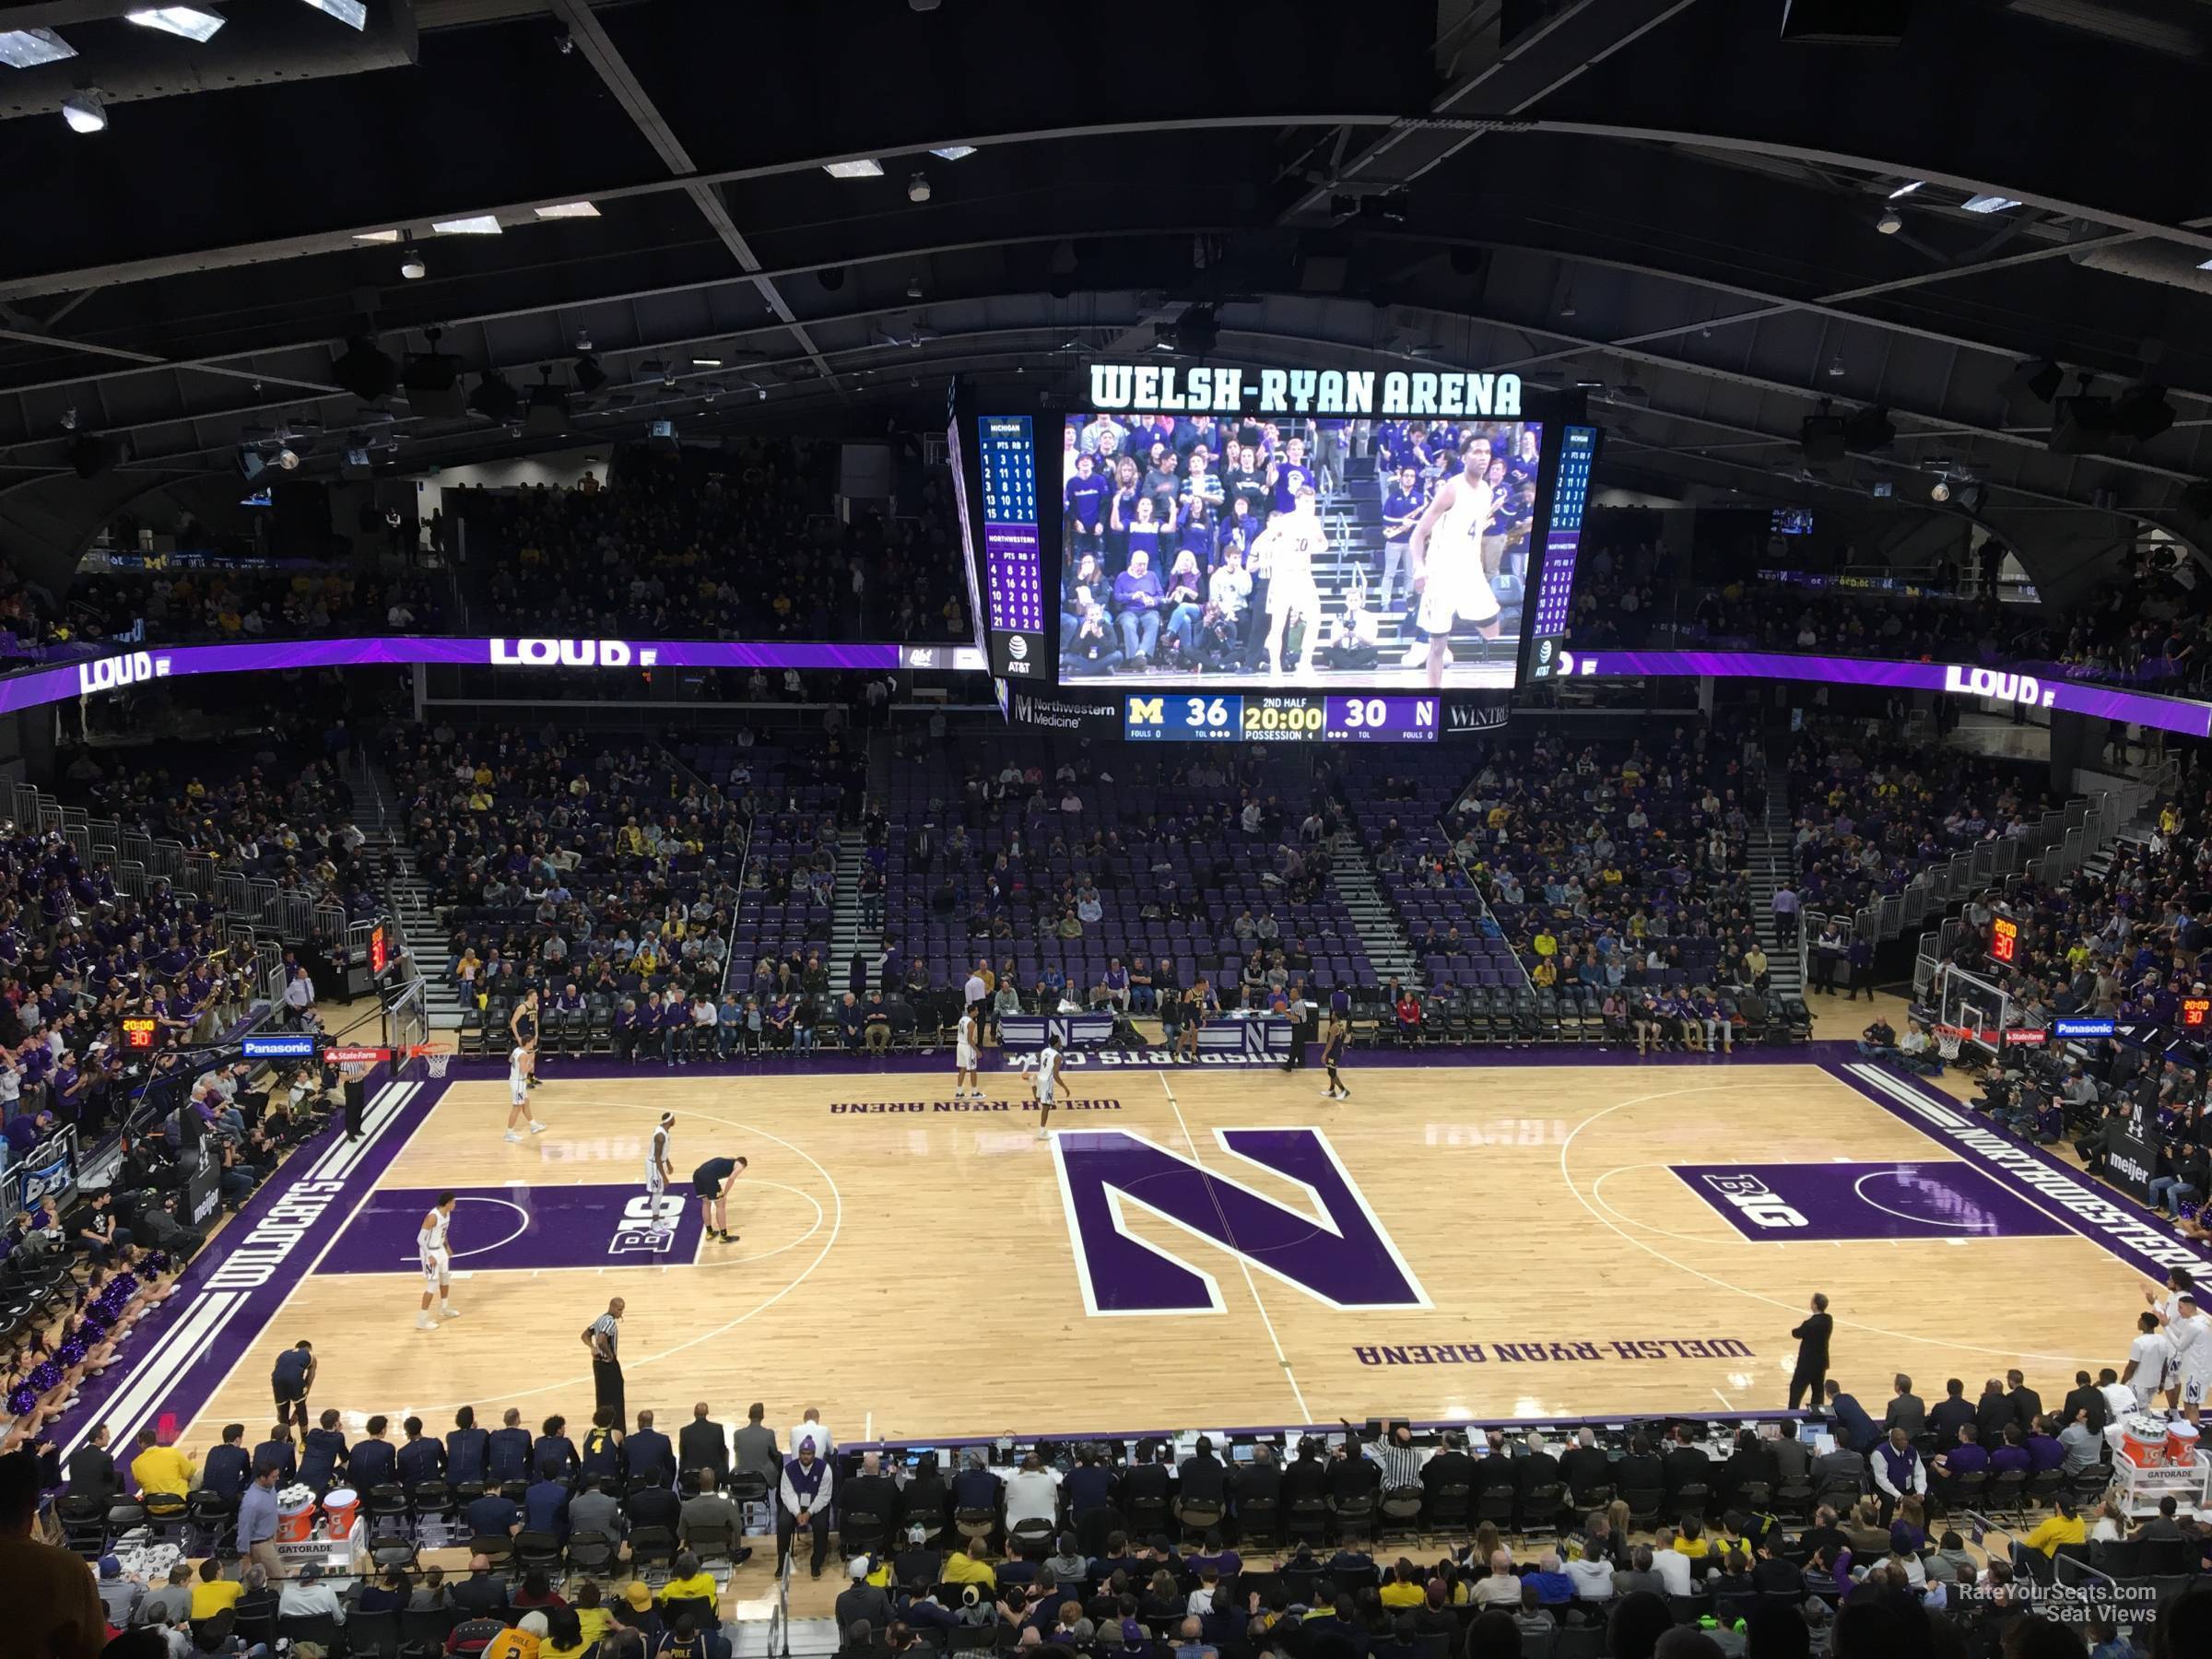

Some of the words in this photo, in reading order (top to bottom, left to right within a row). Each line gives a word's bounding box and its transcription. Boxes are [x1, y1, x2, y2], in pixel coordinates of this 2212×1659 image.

[1090, 364, 1376, 413] WELSH-RYAN
[1382, 371, 1523, 416] ARENA
[997, 441, 1009, 450] PTS
[1012, 441, 1021, 450] RB
[1025, 441, 1030, 450] F
[983, 454, 989, 465] 1
[1000, 454, 1006, 465] 3
[1014, 454, 1019, 465] 1
[1025, 454, 1030, 465] 1
[984, 468, 991, 478] 2
[999, 468, 1008, 478] 11
[1015, 468, 1019, 478] 1
[1026, 468, 1032, 479] 0
[1560, 465, 1564, 474] 1
[1570, 465, 1574, 474] 3
[1579, 465, 1583, 475] 1
[1585, 465, 1589, 475] 1
[985, 481, 991, 492] 3
[1002, 481, 1008, 492] 8
[1015, 481, 1021, 492] 3
[1027, 482, 1032, 492] 1
[1558, 477, 1563, 488] 2
[1567, 477, 1573, 488] 11
[1576, 477, 1580, 488] 1
[986, 495, 995, 505] 13
[1001, 495, 1011, 506] 10
[1017, 495, 1021, 506] 1
[1028, 495, 1033, 506] 0
[1556, 490, 1560, 500] 3
[1573, 491, 1578, 500] 3
[1581, 491, 1584, 500] 1
[987, 508, 996, 519] 15
[1004, 509, 1009, 519] 4
[1017, 509, 1023, 520] 2
[1029, 509, 1033, 520] 1
[1554, 503, 1560, 513] 13
[1572, 504, 1576, 513] 1
[1552, 517, 1559, 527] 15
[1562, 517, 1566, 527] 4
[1570, 517, 1574, 527] 2
[1576, 517, 1580, 527] 1
[989, 535, 1035, 544] NORTHWESTERN
[1004, 552, 1016, 560] PTS
[1030, 553, 1036, 561] F
[991, 564, 996, 574] 4
[1006, 565, 1013, 575] 8
[1020, 566, 1026, 576] 2
[1031, 566, 1037, 577] 3
[1543, 572, 1547, 582] 4
[1560, 571, 1566, 582] 2
[1567, 571, 1571, 582] 3
[992, 577, 997, 588] 5
[1006, 578, 1016, 589] 16
[1020, 579, 1027, 590] 4
[1032, 580, 1038, 590] 0
[1541, 585, 1547, 595] 5
[1559, 584, 1563, 594] 4
[992, 591, 1002, 601] 10
[1009, 592, 1014, 602] 2
[1021, 593, 1028, 603] 0
[1033, 593, 1038, 603] 0
[1548, 598, 1554, 607] 2
[1557, 597, 1561, 607] 0
[993, 604, 1002, 614] 14
[1009, 605, 1016, 615] 4
[1022, 606, 1029, 616] 0
[1033, 606, 1039, 617] 2
[1537, 611, 1544, 621] 14
[1547, 611, 1551, 620] 4
[1555, 610, 1559, 620] 0
[1561, 610, 1566, 619] 2
[994, 617, 1002, 627] 21
[1010, 618, 1017, 628] 0
[1023, 618, 1029, 629] 2
[1034, 619, 1040, 629] 0
[1535, 625, 1542, 634] 21
[1545, 624, 1549, 633] 0
[1552, 623, 1558, 632] 2
[490, 639, 631, 665] LOUD
[79, 651, 152, 694] LOUD
[1008, 662, 1030, 674] AT&T
[1535, 665, 1550, 677] AT&T
[1946, 665, 2039, 704] LOUD
[1034, 698, 1115, 716] Northwestern
[1263, 698, 1281, 708] 2ND
[1284, 698, 1307, 708] HALF
[1129, 698, 1164, 724] M
[1185, 698, 1228, 726] 36
[1345, 699, 1387, 727] 30
[1416, 701, 1433, 726] N
[1034, 712, 1079, 729] Medicine
[1245, 708, 1323, 730] 20:00
[1156, 730, 1161, 738] 0
[1245, 731, 1301, 740] POSSESSION
[1428, 731, 1433, 739] 0
[1994, 919, 2017, 938] 20:00
[1994, 934, 2013, 959] 30
[2184, 1001, 2209, 1010] 20:00
[2187, 1011, 2202, 1024] 30
[123, 1019, 155, 1031] 20:00
[2058, 1023, 2112, 1034] Panasonic
[130, 1033, 149, 1046] 30
[1246, 1022, 1265, 1053] N
[245, 1043, 312, 1054] Panasonic
[830, 1102, 924, 1113] ARENA
[2110, 1152, 2149, 1184] meijer
[194, 1187, 219, 1224] meijer
[1944, 1127, 2212, 1277] NORTHWESTERN
[1048, 1125, 1437, 1316] N
[201, 1182, 345, 1289] WILDCATS
[1352, 1343, 1488, 1366] ARENA
[1494, 1338, 1757, 1362] WELSH-RYAN
[2189, 1384, 2197, 1398] N
[2147, 1470, 2193, 1478] GATORADE
[278, 1545, 333, 1554] GATORADE
[671, 1648, 692, 1658] POOLE
